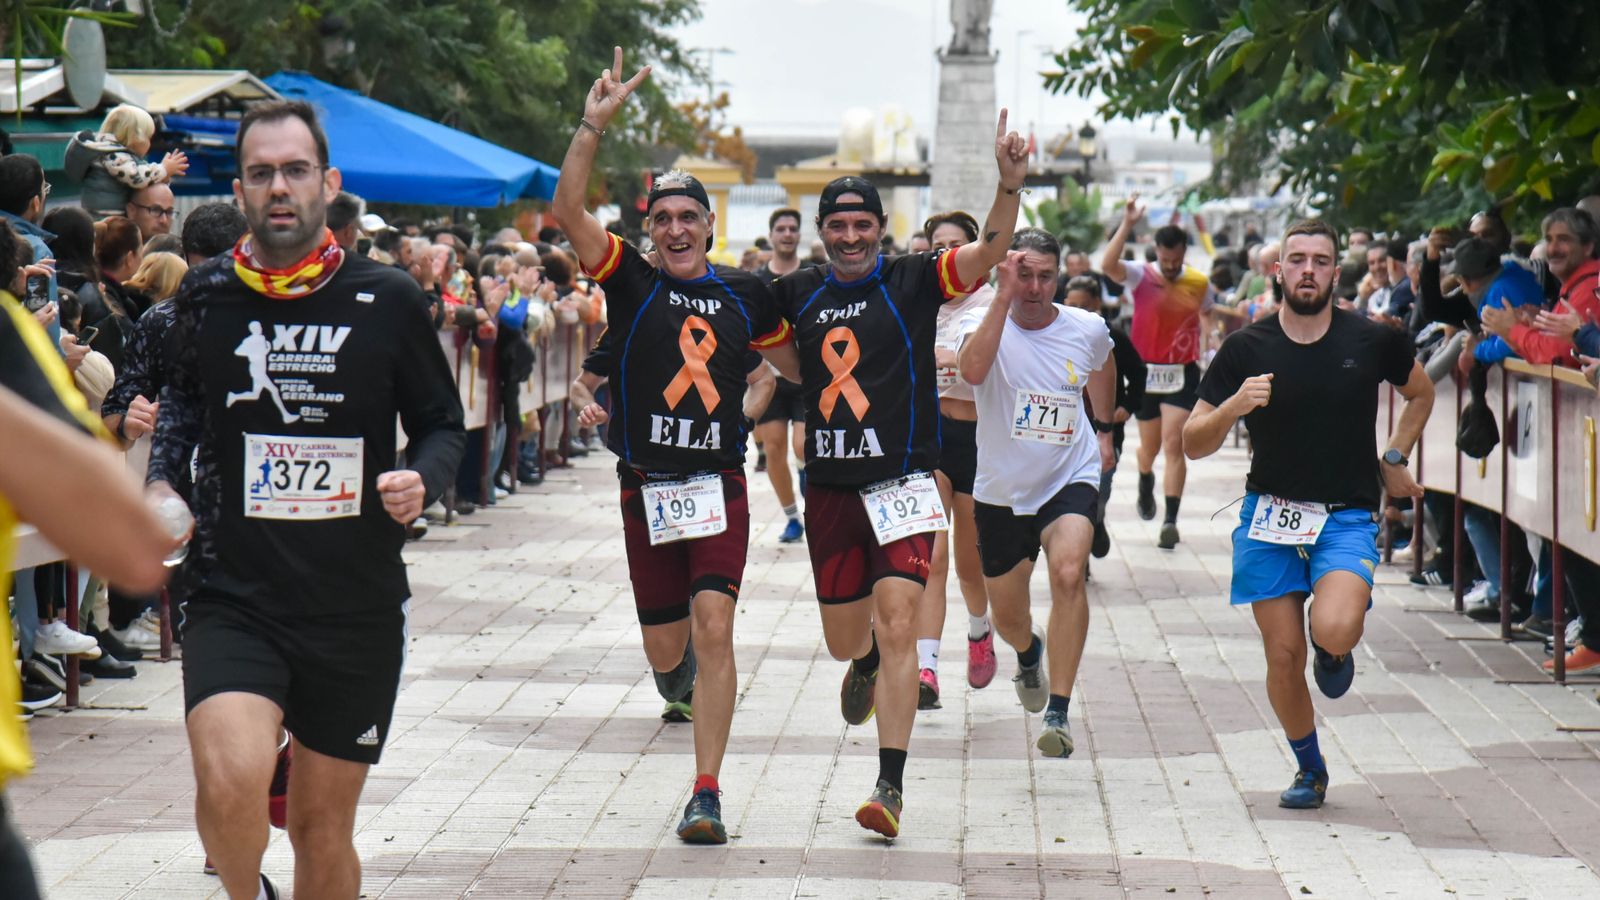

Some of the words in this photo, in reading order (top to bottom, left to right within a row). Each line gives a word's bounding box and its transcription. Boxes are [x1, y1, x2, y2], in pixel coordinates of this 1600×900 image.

[669, 290, 722, 314] STOP
[816, 300, 868, 324] STOP
[272, 324, 352, 353] XIV
[268, 354, 331, 363] CARRERA
[268, 363, 336, 373] ESTRECHO
[280, 384, 315, 392] PEPE
[282, 392, 344, 402] SERRANO
[1029, 394, 1049, 405] XIV
[300, 406, 311, 416] 8
[1038, 405, 1059, 426] 71
[649, 414, 721, 449] ELA
[265, 442, 300, 458] XIV
[815, 428, 885, 459] ELA
[274, 459, 331, 490] 372
[656, 488, 678, 501] XIV
[878, 490, 899, 503] XIV
[1271, 496, 1290, 507] XIV
[670, 497, 696, 520] 99
[893, 496, 921, 518] 92
[1277, 508, 1302, 530] 58
